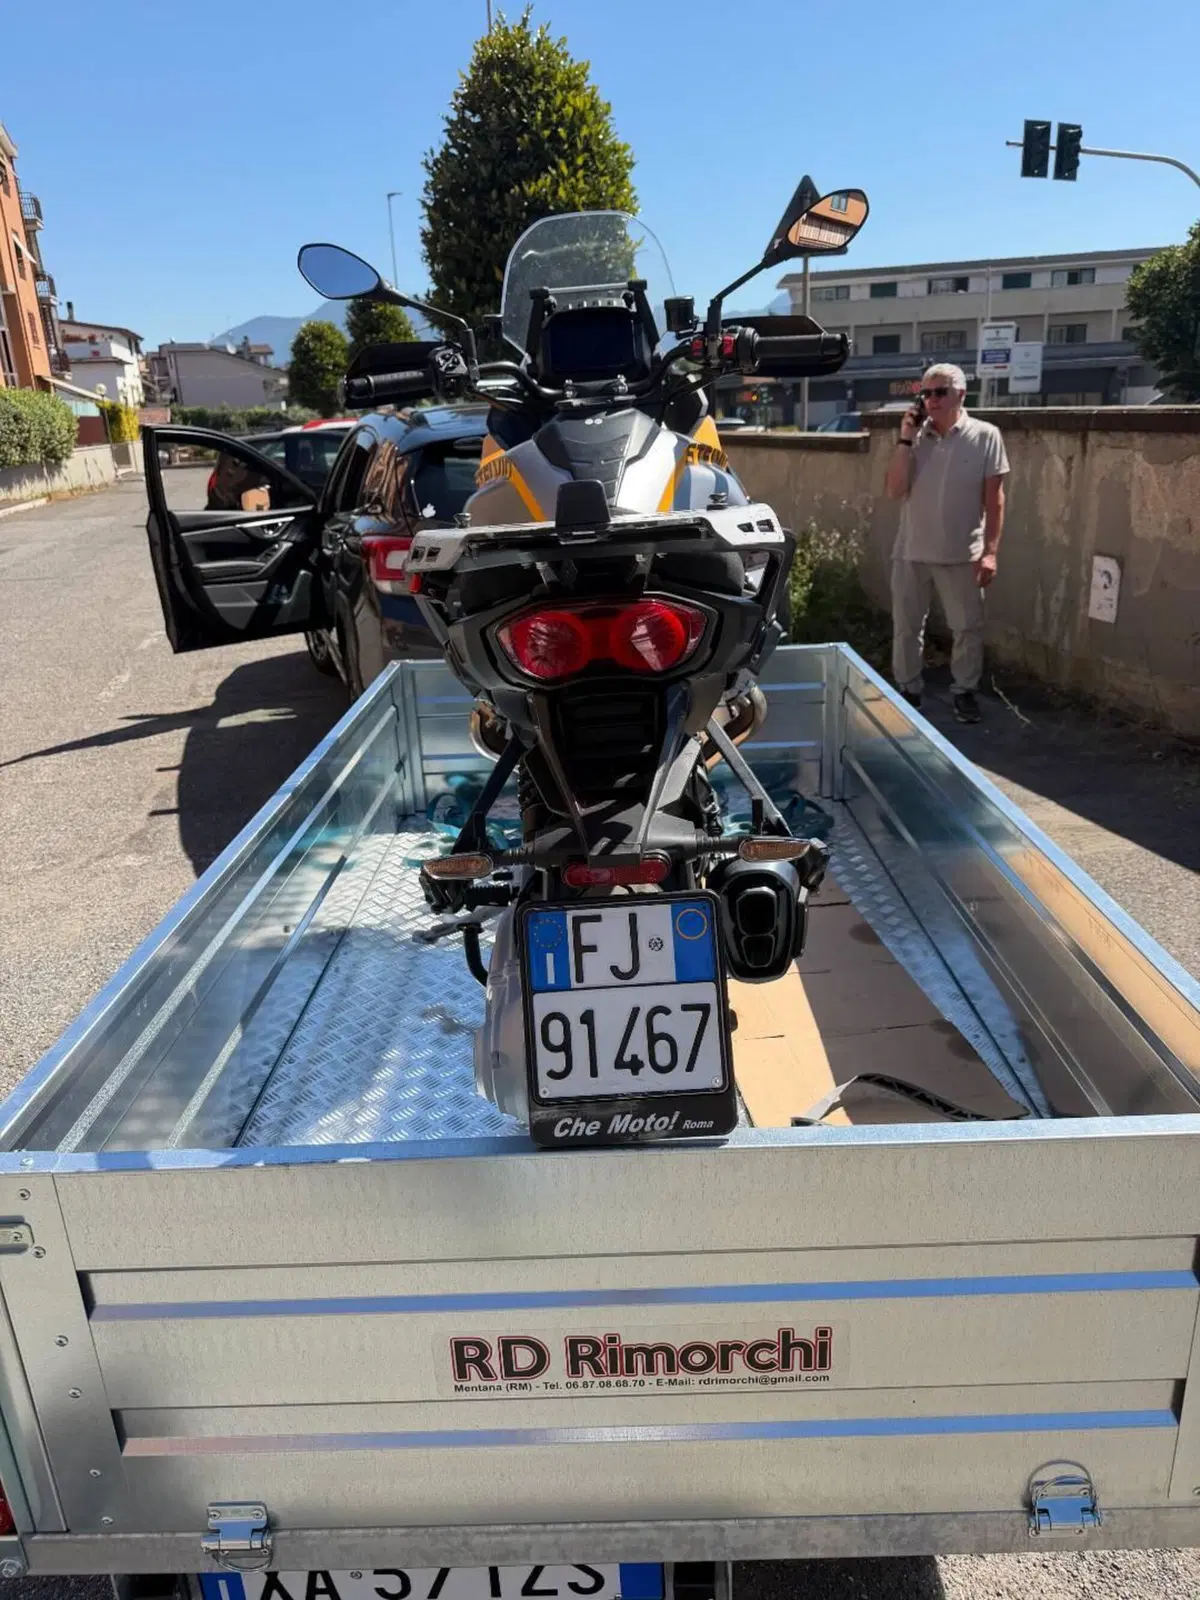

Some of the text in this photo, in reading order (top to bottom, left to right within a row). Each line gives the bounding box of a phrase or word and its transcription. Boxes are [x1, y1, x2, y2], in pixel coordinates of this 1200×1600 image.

[572, 912, 640, 984] FJ
[541, 1003, 711, 1080] 91467
[554, 1111, 713, 1138] Che Moto! Roma
[450, 1327, 832, 1382] RD Rimorchi
[454, 1383, 502, 1393] Mentana
[506, 1382, 532, 1393] (RM)
[543, 1381, 562, 1391] Tel.
[566, 1379, 645, 1390] 06.87.08.68.70
[656, 1377, 695, 1387] E-Mail:
[698, 1374, 830, 1386] rdrimorchi@gmail.com
